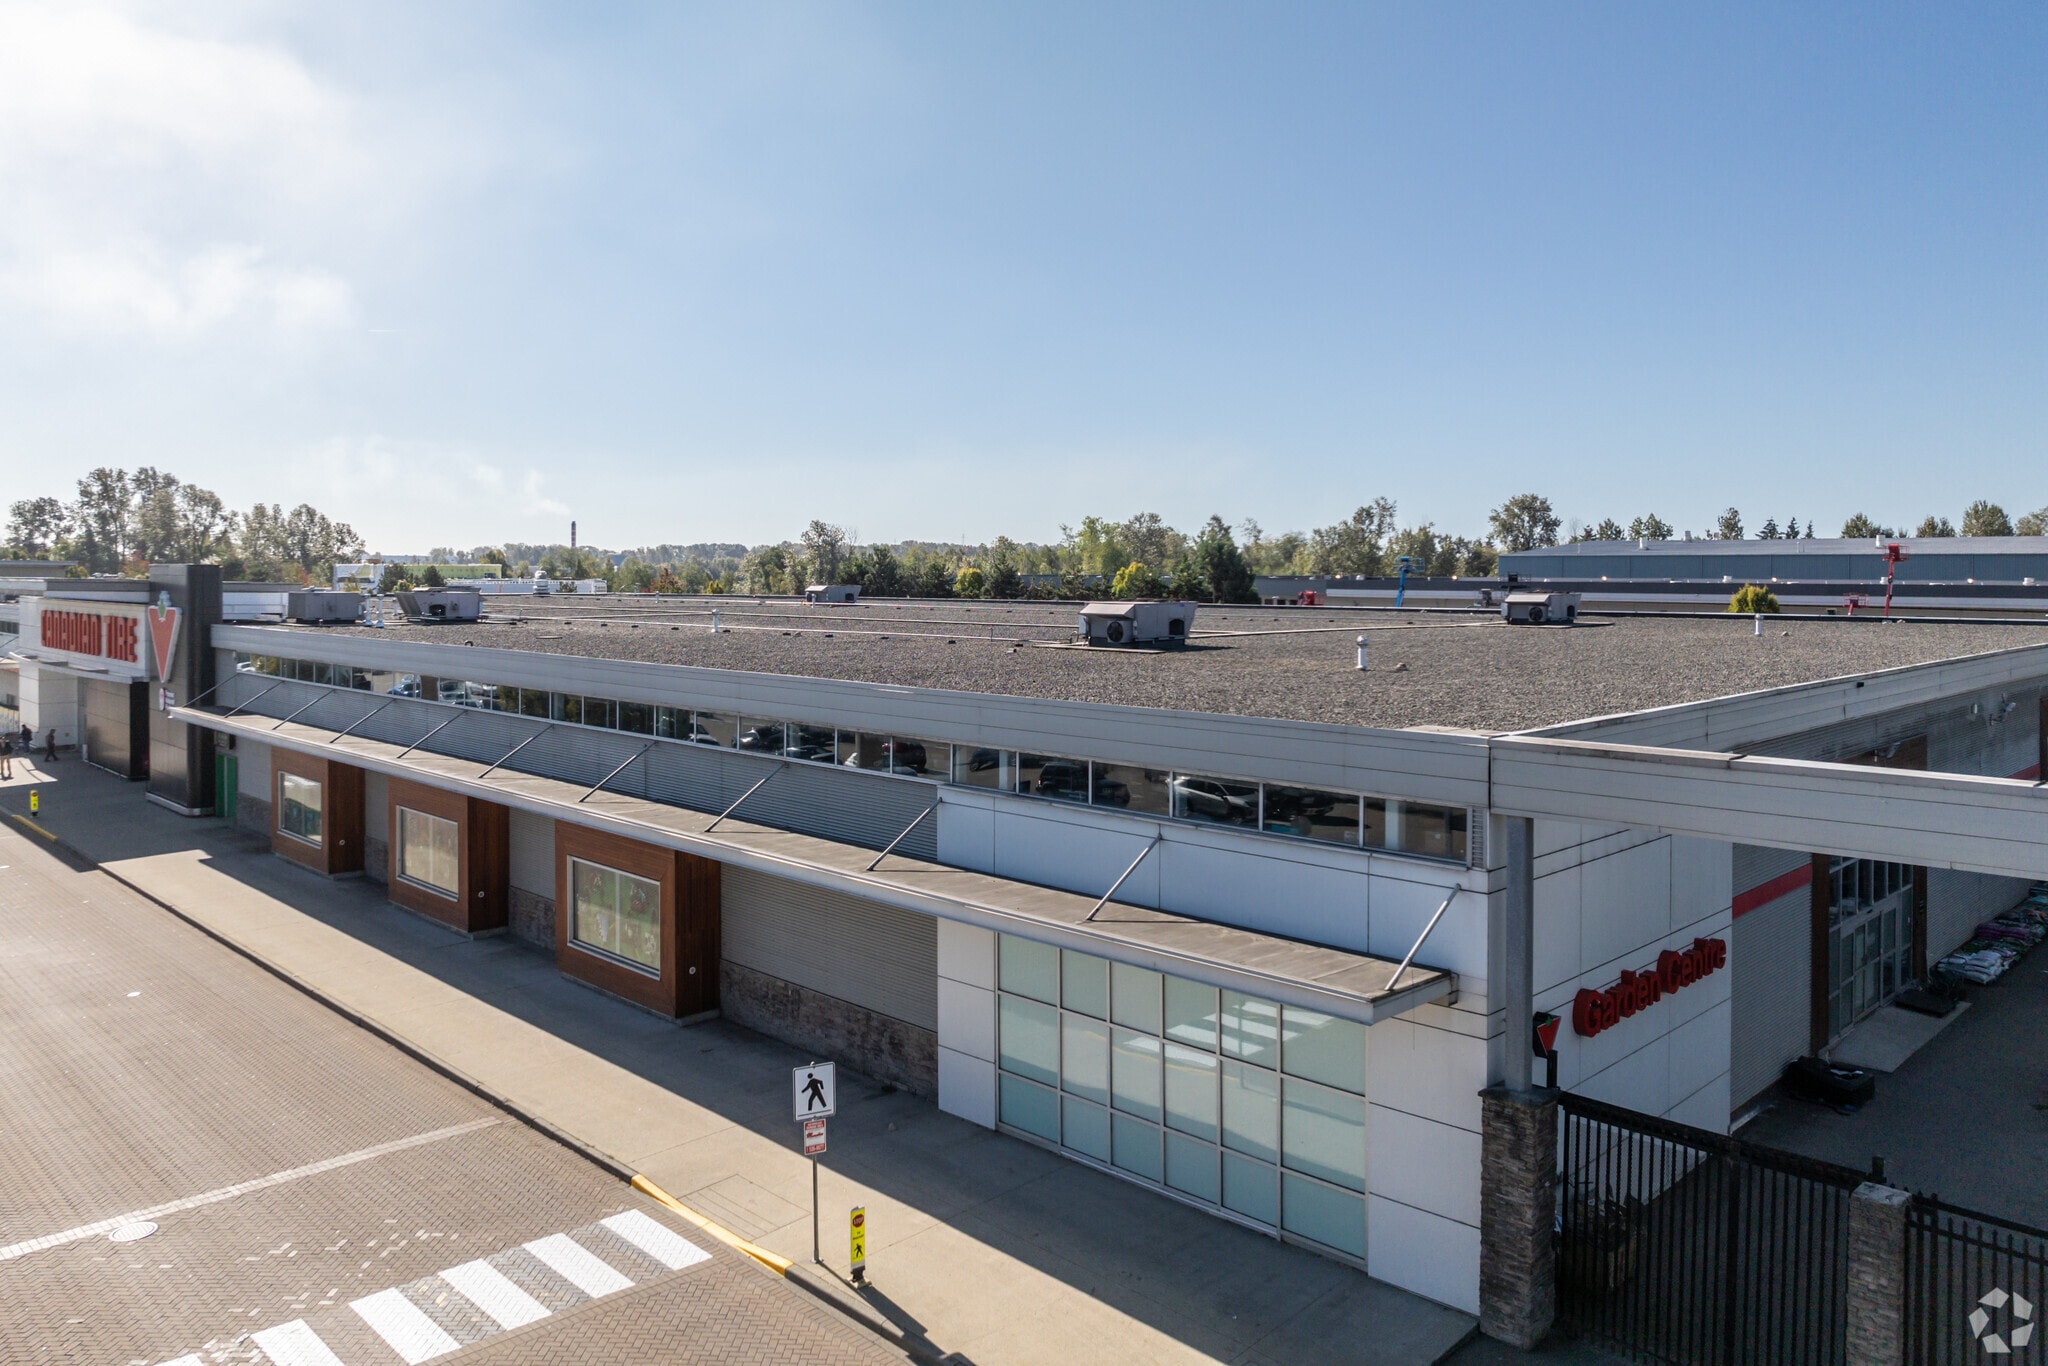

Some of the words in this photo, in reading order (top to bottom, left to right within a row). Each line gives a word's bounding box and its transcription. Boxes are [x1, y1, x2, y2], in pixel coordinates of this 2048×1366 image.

[41, 610, 102, 656] CANADIAN
[104, 615, 138, 662] TIRE
[1573, 969, 1662, 1038] Garden
[1657, 938, 1727, 994] Centre
